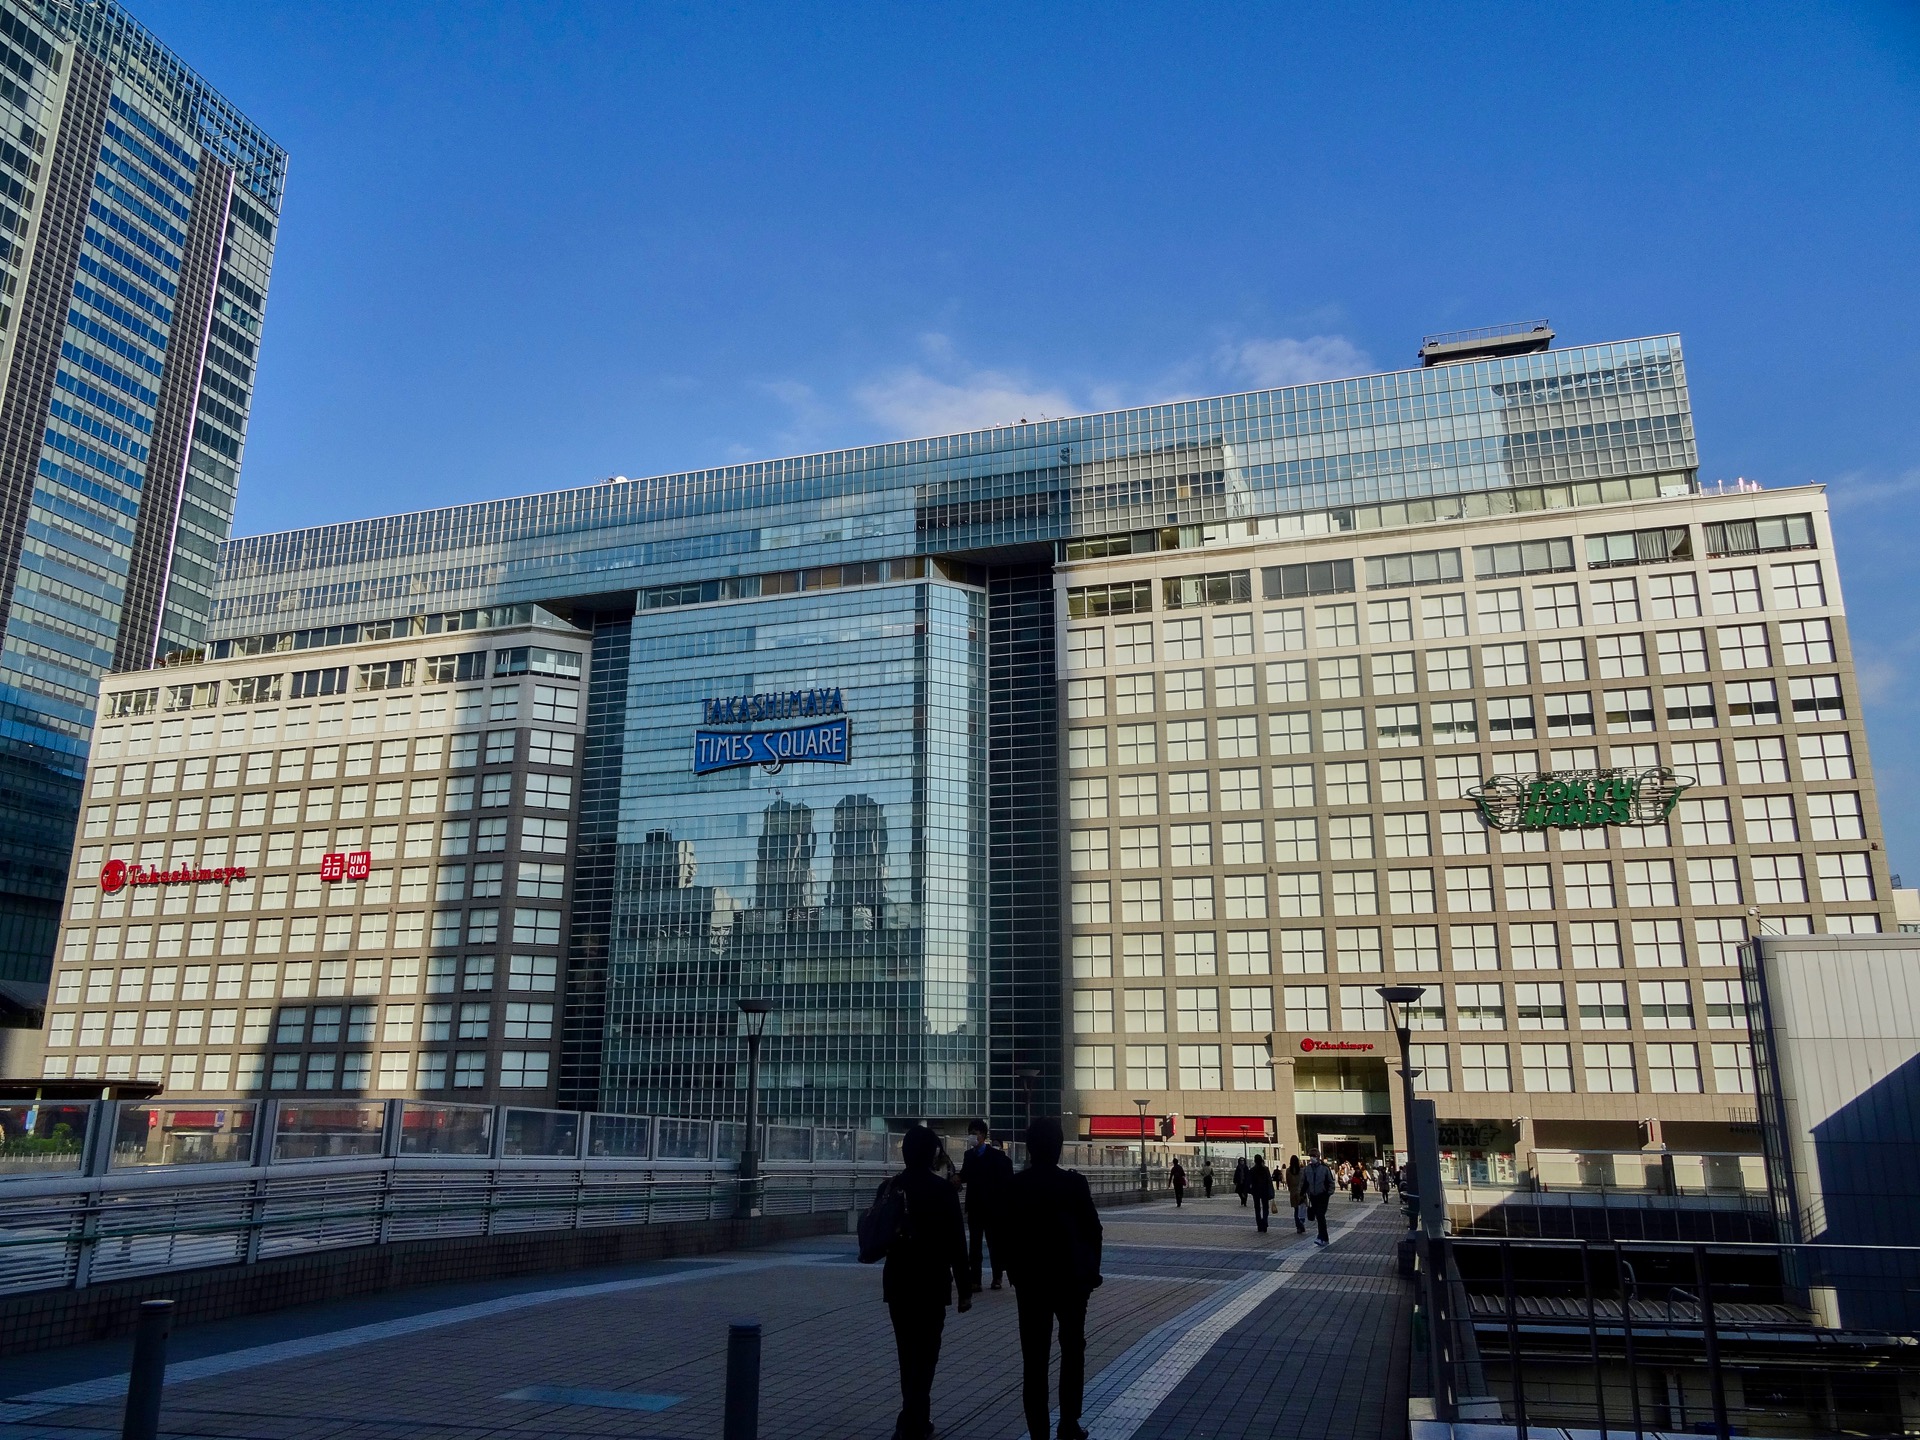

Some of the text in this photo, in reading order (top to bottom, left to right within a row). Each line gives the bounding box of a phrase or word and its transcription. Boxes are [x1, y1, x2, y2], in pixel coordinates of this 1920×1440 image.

[702, 686, 844, 724] TAKASHIMAYA
[699, 727, 842, 773] TIMES SQUARE
[1529, 778, 1633, 804] TOKYU
[1525, 800, 1630, 826] HANDS
[349, 865, 367, 877] QLO
[350, 854, 367, 865] UNI
[128, 862, 246, 886] Takashimaya
[1314, 1041, 1374, 1052] Takashimaya
